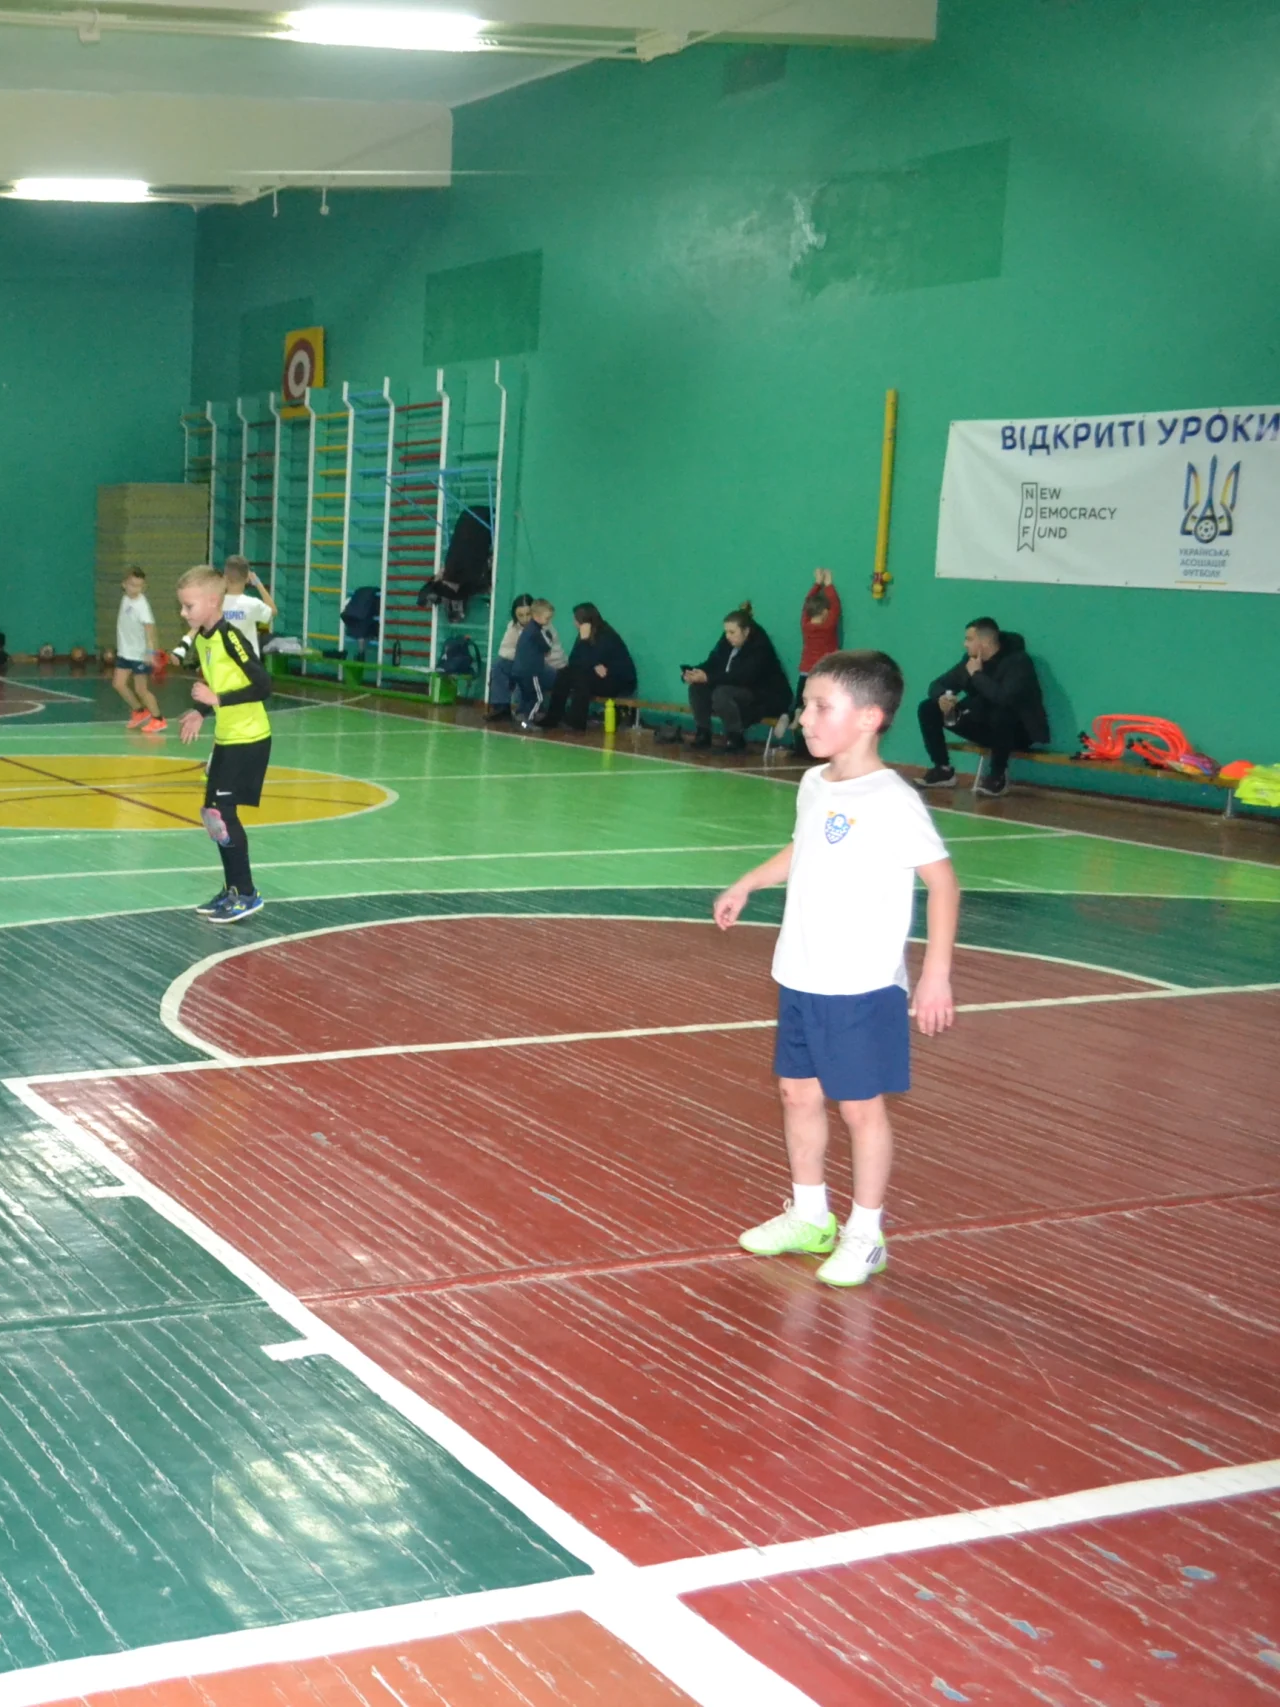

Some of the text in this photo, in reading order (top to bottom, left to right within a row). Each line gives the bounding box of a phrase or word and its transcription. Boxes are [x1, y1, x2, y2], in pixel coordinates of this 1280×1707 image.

[1001, 412, 1280, 456] ВІДКРИТІ УРОКИ
[1024, 487, 1062, 500] NEW
[1024, 506, 1117, 520] DEMOCRACY
[1021, 525, 1068, 539] FUND
